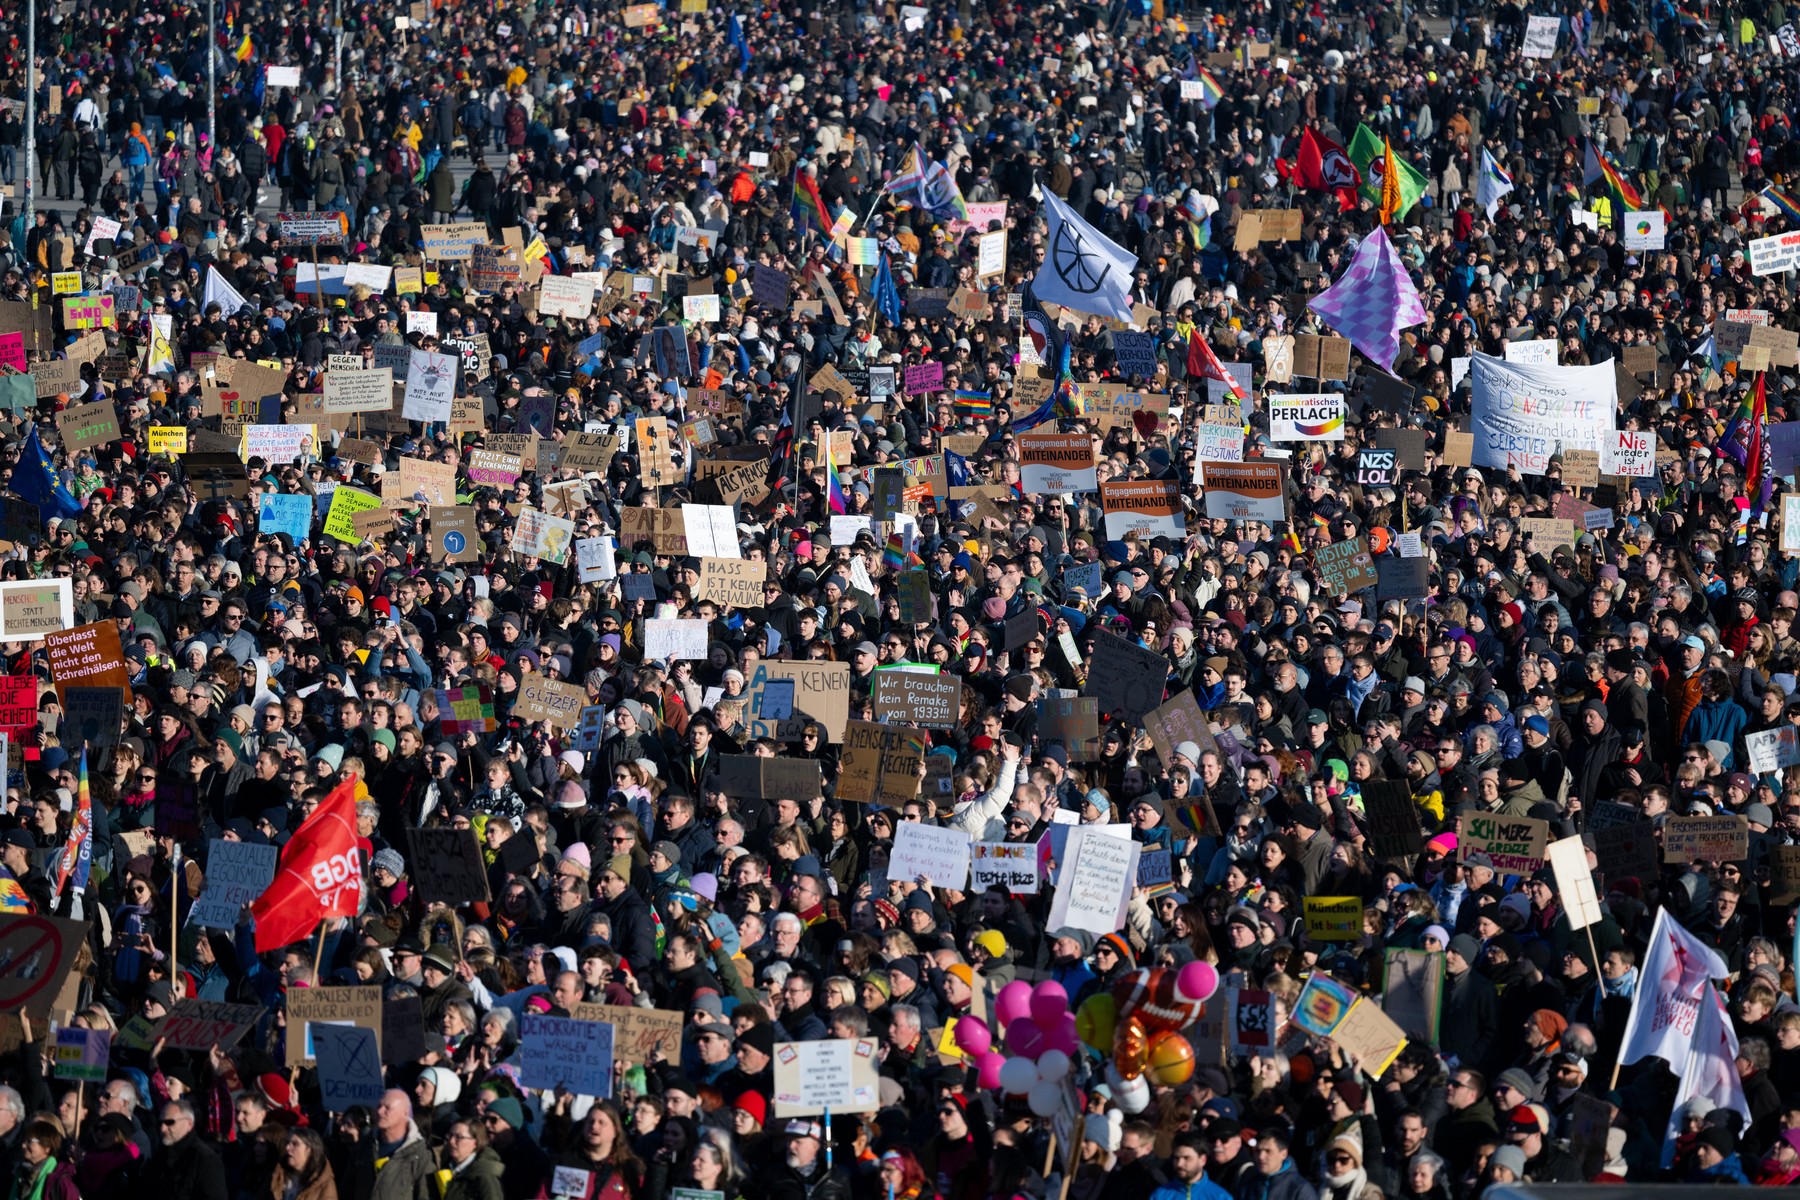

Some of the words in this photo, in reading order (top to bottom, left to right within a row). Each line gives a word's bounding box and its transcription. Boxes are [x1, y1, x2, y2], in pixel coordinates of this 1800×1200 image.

[1116, 334, 1150, 348] RECHTS
[1513, 343, 1544, 354] SIAMO
[1539, 386, 1567, 396] dass
[464, 402, 481, 410] KURZ
[1271, 398, 1339, 406] demokratisches
[1499, 390, 1595, 420] DEMOKRATIE
[63, 415, 78, 424] Nie
[82, 409, 103, 418] wieder
[1210, 406, 1237, 419] FÜR
[1272, 408, 1339, 420] PERLACH
[74, 422, 112, 440] JETZT!
[1200, 424, 1244, 439] HERKUNFT
[486, 434, 503, 443] WAS
[505, 434, 531, 443] HALTEN
[578, 435, 611, 448] BLAU
[1022, 439, 1067, 449] Engagement
[1070, 439, 1090, 448] heißt
[1204, 437, 1217, 445] IST
[1220, 438, 1239, 449] KEINE
[1620, 432, 1646, 449] Nie
[474, 450, 501, 460] FAZIT
[502, 455, 520, 464] EINER
[566, 455, 604, 466] NULLE
[1023, 450, 1091, 461] MITEINANDER
[1201, 448, 1240, 460] LEISTUNG
[1564, 452, 1580, 461] WIR
[1614, 449, 1649, 458] wieder
[405, 459, 416, 470] The
[1359, 453, 1394, 470] NZS
[1616, 461, 1652, 475] jetzt!
[720, 472, 740, 495] ALS
[739, 458, 770, 486] MENSCH
[1206, 466, 1253, 476] Engagement
[1256, 467, 1277, 476] heißt
[1358, 470, 1390, 484] LOL
[1047, 481, 1063, 489] WIR
[1104, 485, 1153, 497] Engagement
[1156, 485, 1177, 494] heißt
[1206, 478, 1278, 490] MITEINANDER
[743, 485, 760, 498] FÜR
[274, 498, 288, 506] Wir
[1106, 496, 1179, 510] MITEINANDER
[1232, 508, 1249, 516] WIR
[636, 510, 671, 531] AFD
[1314, 536, 1360, 564] HISTORY
[708, 562, 742, 574] HASS
[1320, 562, 1337, 575] HAS
[1338, 558, 1350, 568] ITS
[1324, 572, 1345, 583] EYES
[1346, 567, 1360, 579] ON
[707, 578, 725, 588] IST
[731, 580, 761, 592] KEINE
[1330, 582, 1348, 598] US
[706, 590, 763, 605] MEINUNG
[22, 606, 43, 615] STATT
[5, 618, 29, 629] RECHTE
[30, 616, 60, 627] MENSCHEN
[47, 628, 97, 646] Überlasst
[51, 648, 67, 658] die
[69, 642, 95, 655] Welt
[685, 648, 706, 658] DUMM
[53, 658, 79, 670] nicht
[82, 652, 101, 664] den
[55, 660, 122, 681] Schreihälsen.
[544, 679, 563, 691] KEIN
[801, 670, 849, 692] KENEN
[880, 676, 898, 688] Wir
[904, 676, 954, 693] brauchen
[0, 691, 19, 705] DIE
[879, 692, 901, 704] kein
[907, 692, 948, 707] Remake
[530, 703, 543, 713] FÜR
[546, 708, 563, 718] NAZIS
[913, 707, 949, 719] 1933!!!
[850, 727, 906, 752] MENSCHEN-
[1754, 734, 1776, 749] AFD
[881, 755, 919, 778] RECHTE
[1672, 821, 1711, 832] FASCHISTEN
[1712, 820, 1736, 831] HÖREN
[1668, 834, 1683, 842] NICHT
[210, 843, 274, 868] ASOZIALER
[1486, 842, 1529, 855] GRENZE
[898, 854, 918, 863] Aber
[920, 859, 933, 867] alle
[211, 863, 268, 888] EGOISMUS
[976, 871, 1007, 884] rechte
[1009, 872, 1034, 886] Hetze
[204, 885, 221, 901] IST
[224, 887, 262, 904] KEINE
[1308, 903, 1358, 913] München
[1311, 921, 1323, 930] ist
[1326, 920, 1356, 930] bunt!
[288, 990, 306, 1003] THE
[310, 989, 352, 1003] SMALLEST
[357, 989, 379, 1000] MAN
[340, 1005, 374, 1017] LIVED
[573, 1002, 605, 1022] 1933
[609, 1010, 631, 1026] hat
[1237, 1004, 1268, 1016] FCK
[522, 1016, 597, 1040] DEMOKRATIE
[1238, 1017, 1268, 1031] NZS
[544, 1039, 587, 1054] WÄHLEN
[523, 1048, 549, 1058] SONST
[556, 1053, 582, 1064] WIRD
[585, 1055, 598, 1065] ES
